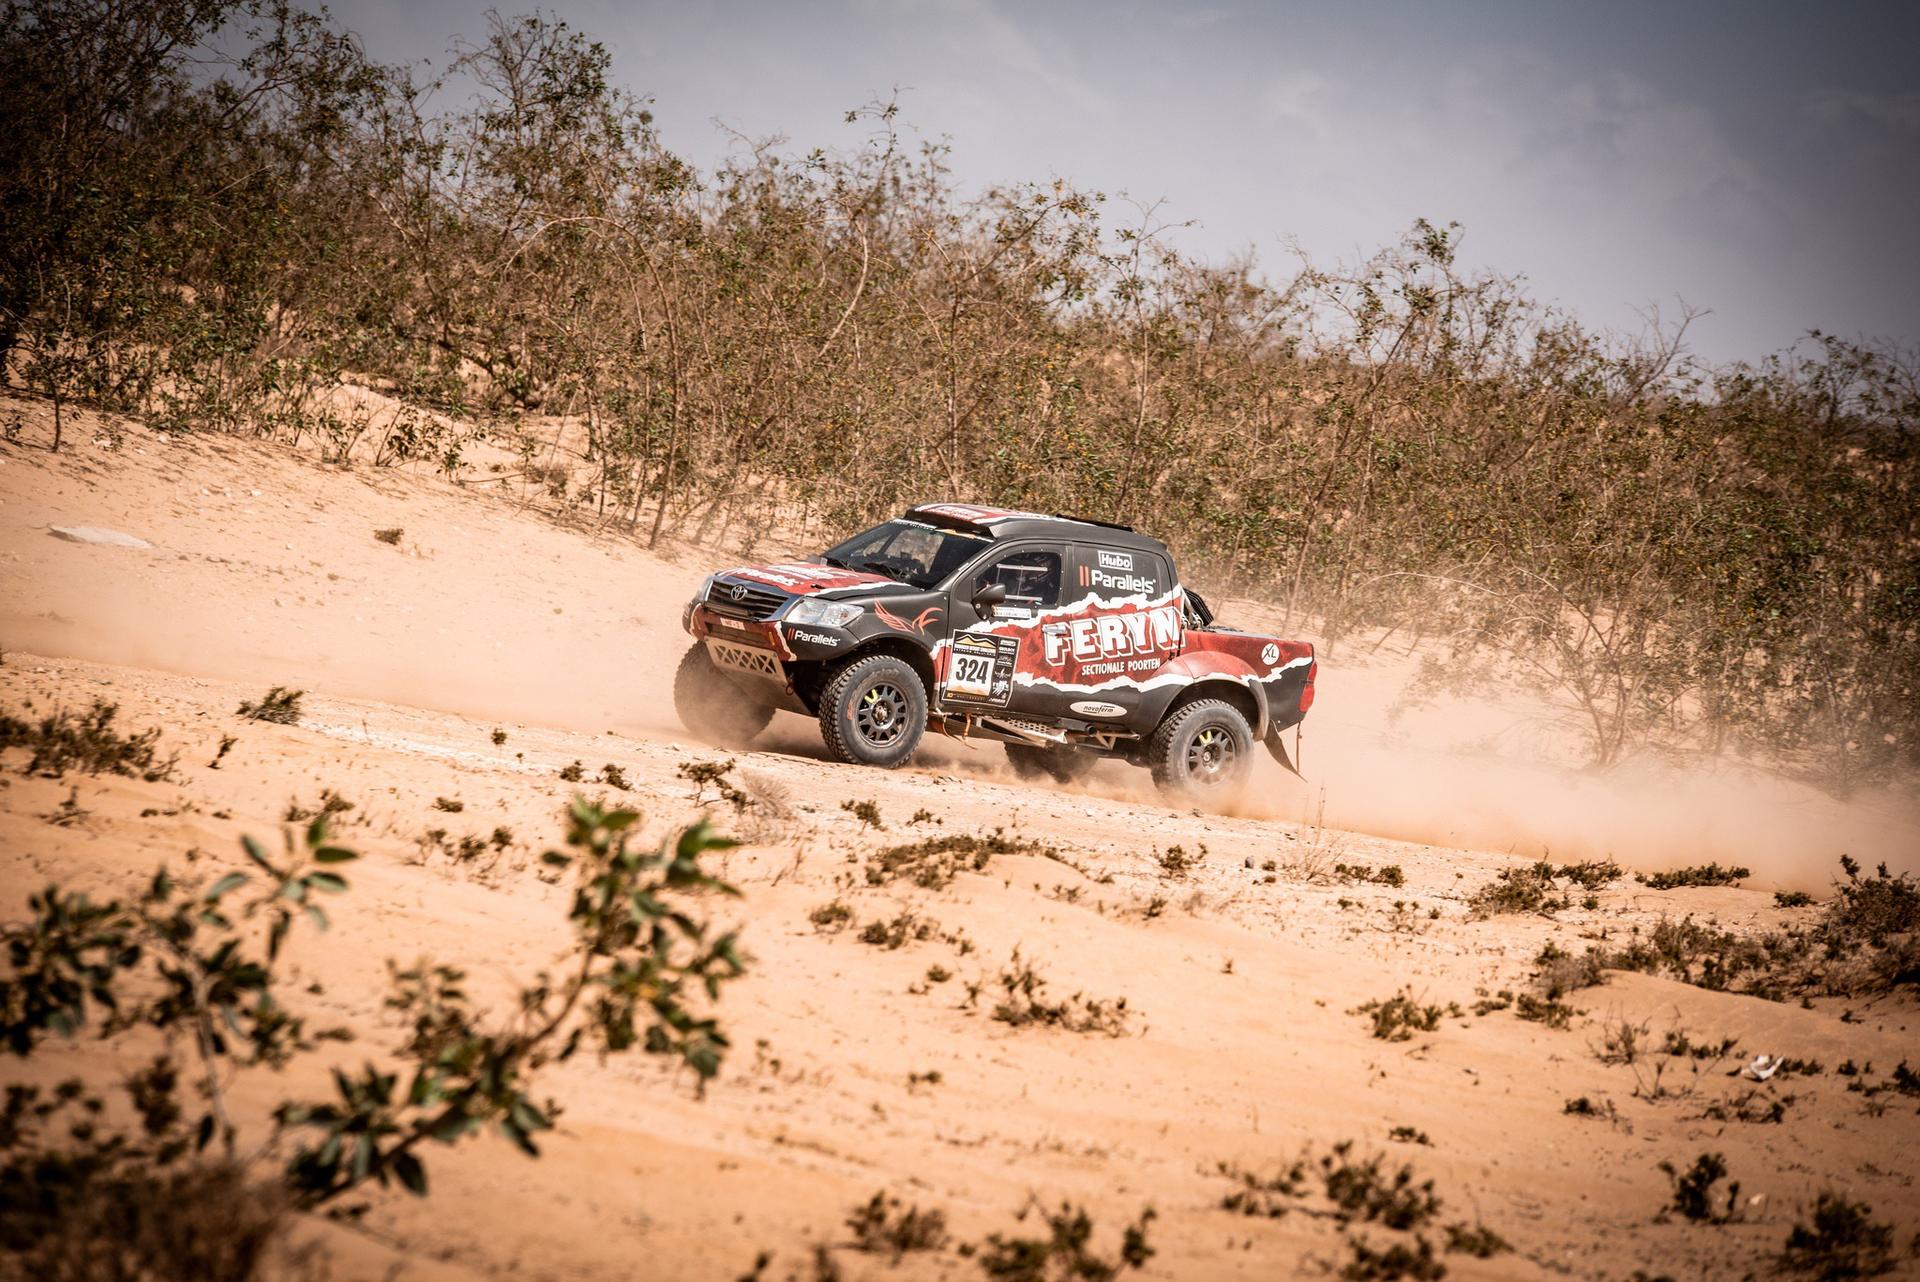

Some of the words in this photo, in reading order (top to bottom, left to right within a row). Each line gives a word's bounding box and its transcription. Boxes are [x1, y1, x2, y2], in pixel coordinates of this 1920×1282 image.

[1101, 553, 1131, 568] Hubo
[1091, 569, 1155, 594] Parallels
[794, 630, 839, 647] Parallels
[1043, 607, 1184, 666] FERYN
[955, 657, 989, 684] 324
[1081, 662, 1125, 676] SECTIONALE
[1127, 657, 1161, 672] POORTEN
[1083, 704, 1114, 713] novoferm
